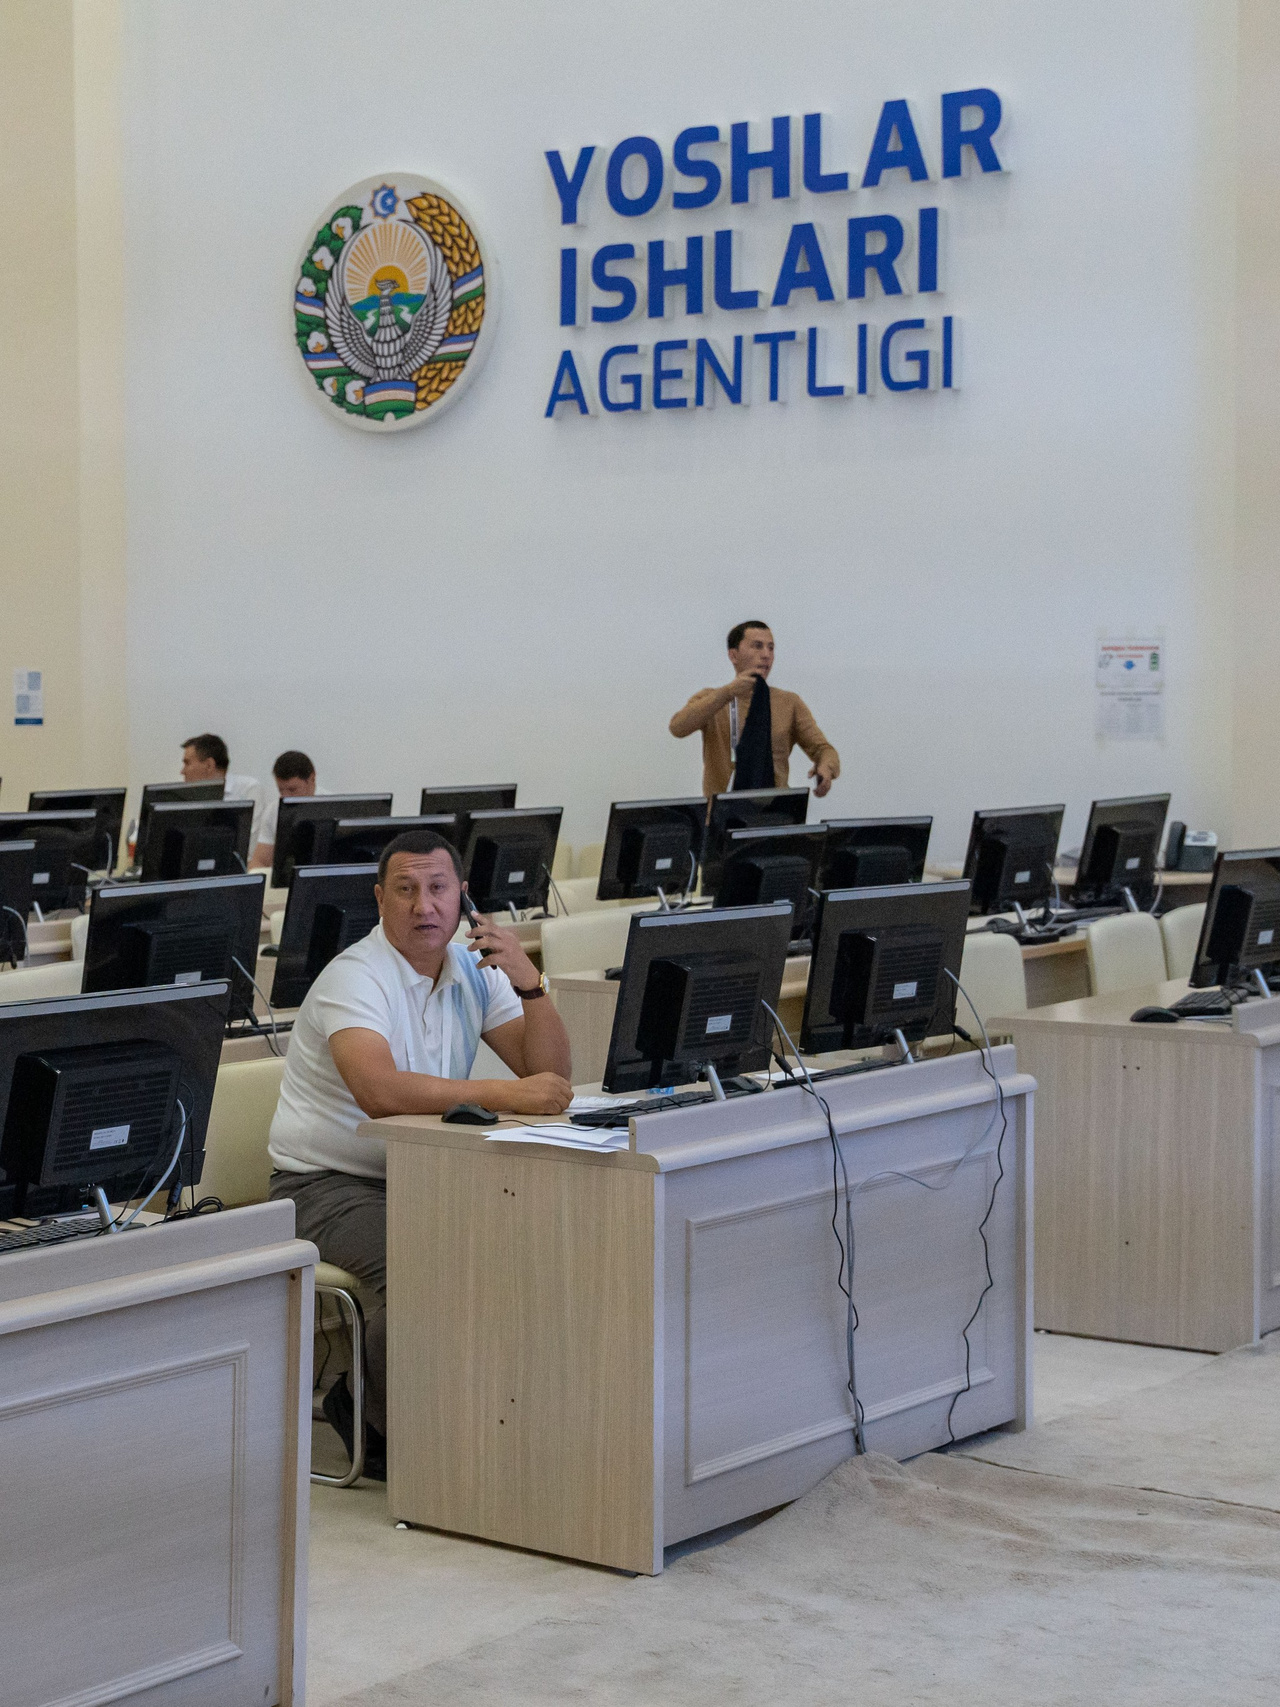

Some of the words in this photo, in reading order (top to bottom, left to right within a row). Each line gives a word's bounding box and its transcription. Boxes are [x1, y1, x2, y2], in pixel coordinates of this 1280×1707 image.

[544, 87, 1003, 225] YOSHLAR
[559, 206, 939, 327] ISHLARI
[544, 315, 954, 419] AGENTLIGI
